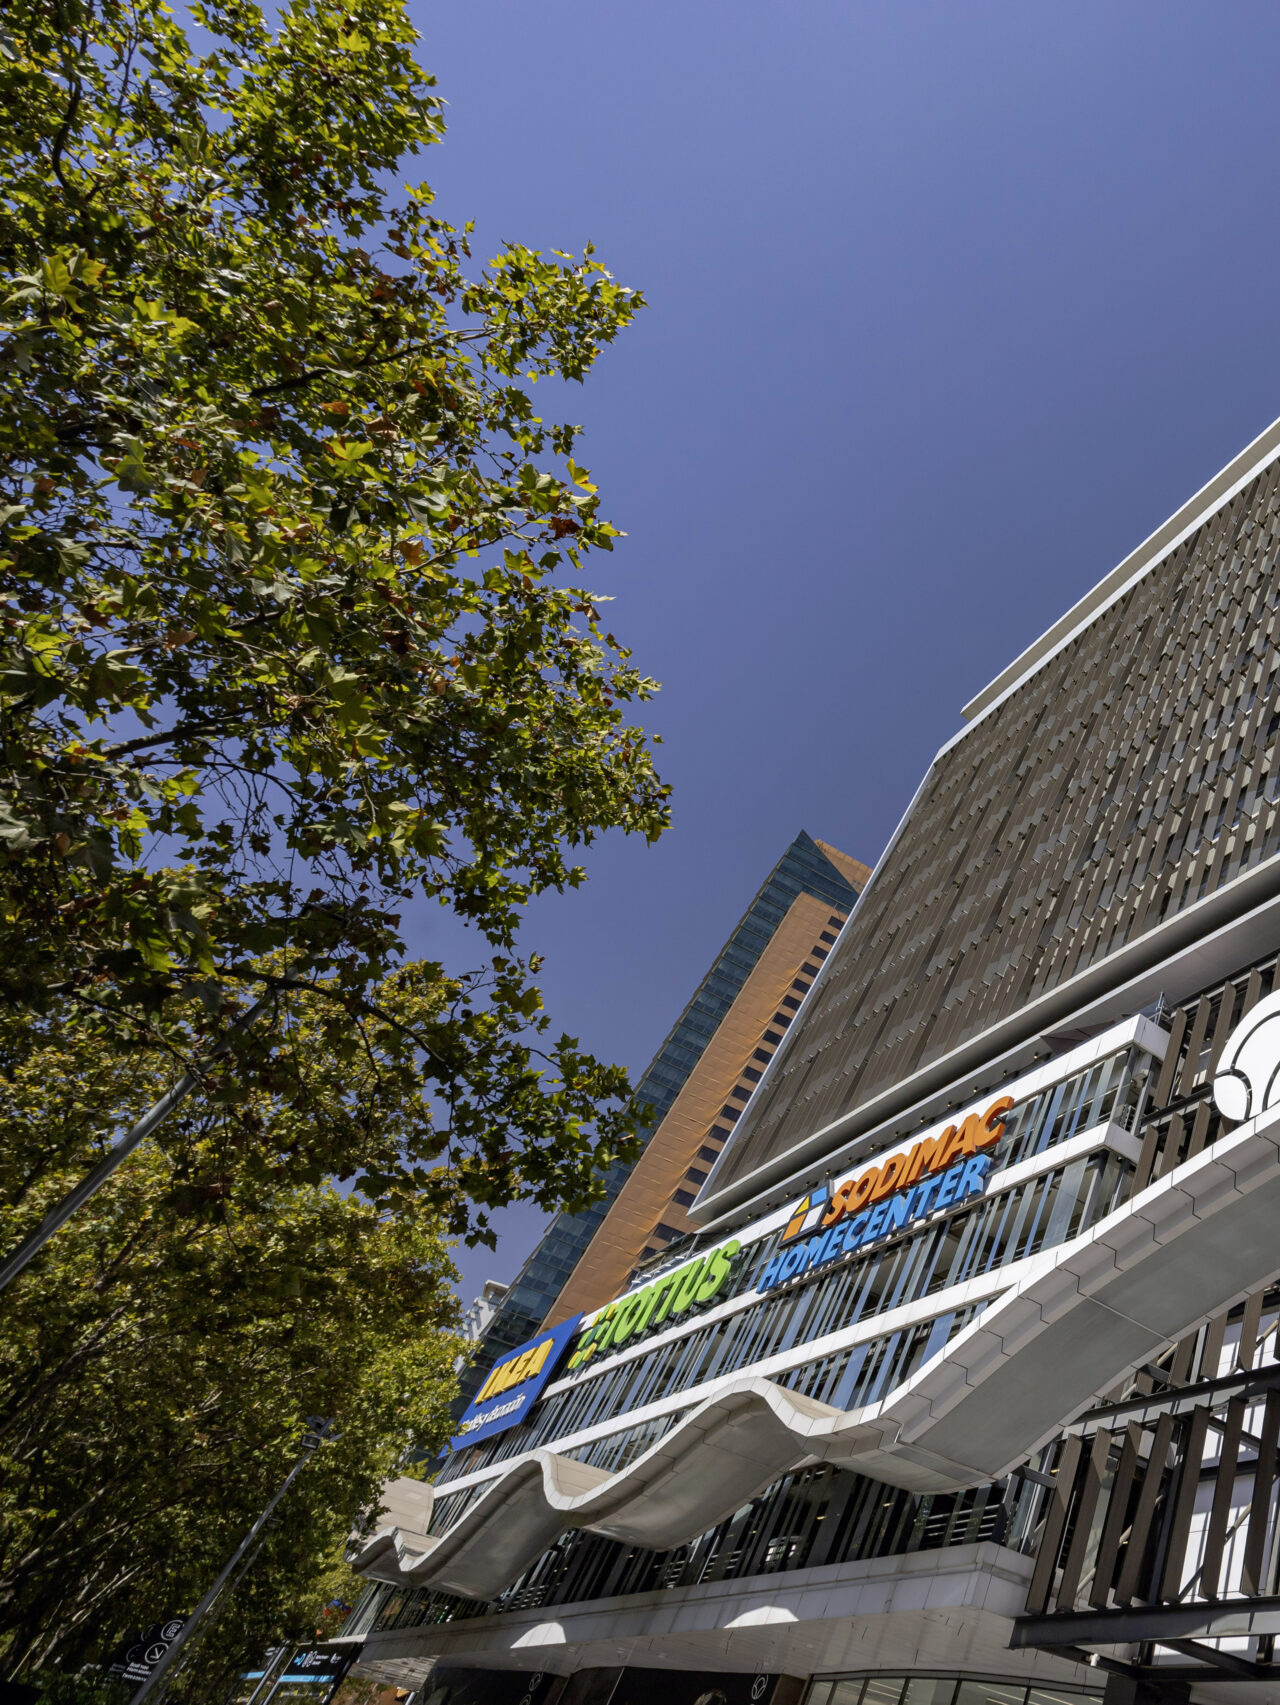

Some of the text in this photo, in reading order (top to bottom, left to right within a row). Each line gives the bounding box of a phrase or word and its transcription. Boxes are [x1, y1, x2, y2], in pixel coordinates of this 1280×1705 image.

[821, 1096, 1015, 1225] SODIMAC
[756, 1153, 991, 1294] HOMECENTER
[598, 1239, 741, 1351] TOTTUS
[473, 1337, 554, 1406] IKEA
